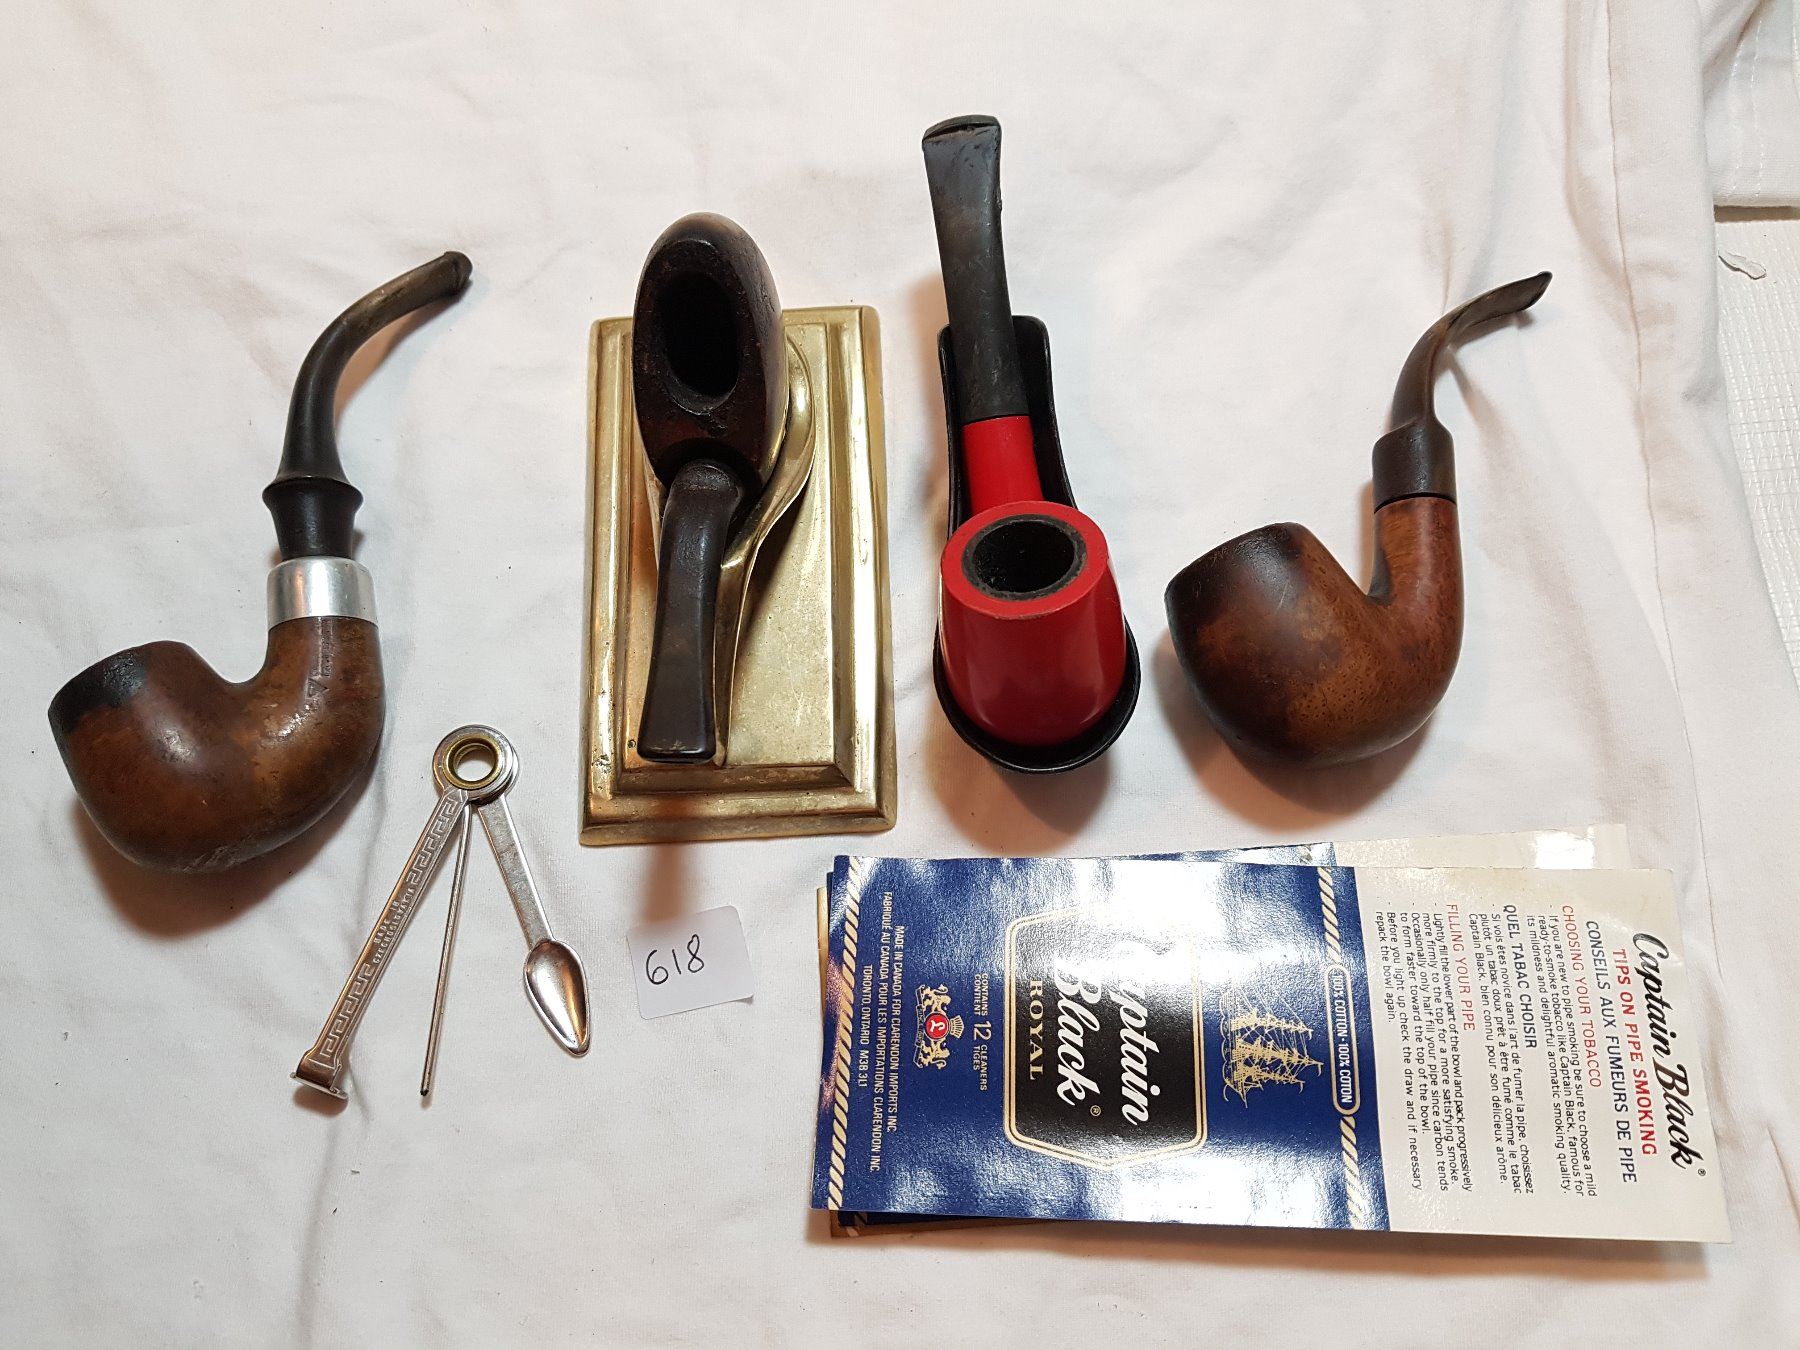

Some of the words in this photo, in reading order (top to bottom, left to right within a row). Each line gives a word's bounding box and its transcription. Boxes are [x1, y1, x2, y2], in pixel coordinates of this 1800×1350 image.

[881, 891, 894, 929] FABRIQUÉ
[1422, 912, 1432, 936] more
[1491, 913, 1501, 921] Si
[1502, 904, 1520, 938] QUEL
[1526, 915, 1535, 926] its
[880, 931, 890, 943] AU
[893, 925, 904, 948] MADE
[1374, 911, 1387, 941] repack
[1386, 912, 1397, 942] Before
[1401, 925, 1411, 947] form
[1411, 912, 1427, 968] Occasionally
[1432, 913, 1445, 943] Lightly
[1445, 904, 1464, 951] FILLING
[1468, 913, 1481, 948] Captain
[1478, 913, 1492, 940] plutôt
[1548, 923, 1560, 941] you
[1561, 905, 1583, 970] CHOOSING
[645, 933, 705, 985] 618
[878, 946, 889, 979] CANADA
[893, 951, 903, 960] IN
[1380, 945, 1390, 961] the
[1389, 946, 1400, 963] you
[1426, 939, 1438, 968] firmly
[1438, 944, 1448, 955] fill
[1440, 956, 1449, 972] the
[1496, 944, 1506, 964] êtes
[1528, 930, 1543, 971] mildness
[1537, 915, 1557, 989] ready-to-smoke
[1554, 943, 1563, 959] are
[1585, 920, 1610, 989] CONSEILS
[891, 962, 902, 996] CANADA
[1382, 965, 1394, 988] bowl
[1393, 968, 1404, 990] light
[1405, 951, 1416, 981] faster
[1454, 957, 1470, 993] YOUR
[1487, 960, 1498, 985] tabac
[1511, 942, 1529, 988] TABAC
[1557, 961, 1567, 982] new
[1612, 948, 1630, 984] TIPS
[877, 982, 888, 1005] POUR
[972, 974, 981, 1015] CONTIENT
[980, 973, 989, 1015] CONTAINS
[1419, 971, 1430, 992] only
[1432, 986, 1442, 1003] the
[1442, 973, 1453, 1000] lower
[1479, 985, 1490, 1005] bien
[1499, 967, 1511, 998] novice
[1536, 975, 1548, 993] and
[1574, 976, 1591, 1014] YOUR
[1632, 933, 1676, 1058] Captain
[891, 999, 901, 1015] FOR
[1383, 992, 1396, 1022] again.
[1409, 984, 1422, 1021] toward
[1422, 996, 1433, 1016] half
[1444, 1001, 1456, 1021] part
[1491, 988, 1502, 1011] doux
[1505, 1001, 1515, 1025] dans
[1551, 992, 1563, 1031] tobacco
[1561, 998, 1573, 1018] pipe
[1599, 996, 1616, 1027] AUX
[1619, 991, 1635, 1015] ON
[859, 1007, 871, 1044] ONTARIO
[877, 1007, 887, 1023] LES
[1334, 1000, 1348, 1036] COTTON
[1399, 1012, 1410, 1041] check
[1425, 1019, 1435, 1032] fill
[1433, 1007, 1444, 1024] top
[1460, 999, 1475, 1030] PIPE
[1483, 1009, 1493, 1040] connu
[1493, 1016, 1506, 1037] prêt
[1519, 993, 1537, 1048] CHOISIR
[1540, 997, 1555, 1046] delightful
[888, 1018, 900, 1069] CLARENDON
[972, 1020, 991, 1040] 12
[1028, 980, 1043, 1080] ROYAL
[1108, 945, 1162, 1126] ptain
[1414, 1025, 1424, 1042] the
[1437, 1028, 1447, 1043] for
[1449, 1035, 1459, 1052] the
[1557, 1034, 1566, 1052] like
[1566, 1021, 1580, 1065] smoking
[1624, 1022, 1643, 1061] PIPE
[873, 1026, 886, 1093] IMPORTATIONS
[972, 1045, 980, 1070] TIGES
[1337, 1042, 1350, 1066] 100%
[1402, 1046, 1412, 1063] the
[1415, 1046, 1424, 1064] top
[1424, 1035, 1436, 1060] your
[1484, 1045, 1496, 1069] pour
[1499, 1051, 1509, 1071] être
[1511, 1052, 1520, 1064] de
[1581, 1019, 1601, 1087] TOBACCO
[979, 1044, 988, 1090] CLEANERS
[1427, 1064, 1438, 1086] pipe
[1440, 1057, 1449, 1084] more
[1451, 1054, 1462, 1077] bowl
[1547, 1050, 1561, 1098] aromatic
[1559, 1055, 1572, 1096] Captain
[1573, 1068, 1582, 1081] be
[1605, 1035, 1628, 1112] FUMEURS
[887, 1072, 898, 1112] IMPORTS
[1339, 1069, 1352, 1102] COTON
[1404, 1068, 1413, 1095] draw
[1418, 1083, 1428, 1101] the
[1453, 1079, 1464, 1097] and
[1489, 1072, 1498, 1091] son
[1502, 1076, 1513, 1103] fumé
[1512, 1067, 1523, 1100] fumer
[1574, 1083, 1584, 1107] sure
[1406, 1100, 1416, 1119] and
[1431, 1089, 1441, 1116] since
[1442, 1088, 1455, 1141] satisfying
[1452, 1099, 1465, 1123] pack
[1632, 1068, 1656, 1154] SMOKING
[1652, 1056, 1703, 1169] Black
[870, 1096, 883, 1151] CLARENDON
[1420, 1105, 1430, 1133] bowl.
[1491, 1095, 1503, 1142] délicieux
[1504, 1107, 1514, 1145] comme
[1553, 1102, 1565, 1148] smoking
[1615, 1119, 1631, 1140] DE
[1432, 1120, 1444, 1156] carbon
[1578, 1124, 1590, 1161] choose
[1408, 1137, 1421, 1190] necessary
[1446, 1145, 1459, 1184] smoke.
[1454, 1125, 1473, 1191] progressively
[1495, 1146, 1507, 1183] arôme.
[1519, 1144, 1533, 1193] choisissez
[1568, 1135, 1580, 1176] famous
[1618, 1147, 1637, 1182] PIPE
[1437, 1160, 1449, 1191] tends
[1510, 1163, 1521, 1193] tabac
[1556, 1152, 1571, 1193] quality.
[1584, 1172, 1597, 1196] mild
[1573, 1179, 1584, 1196] for
